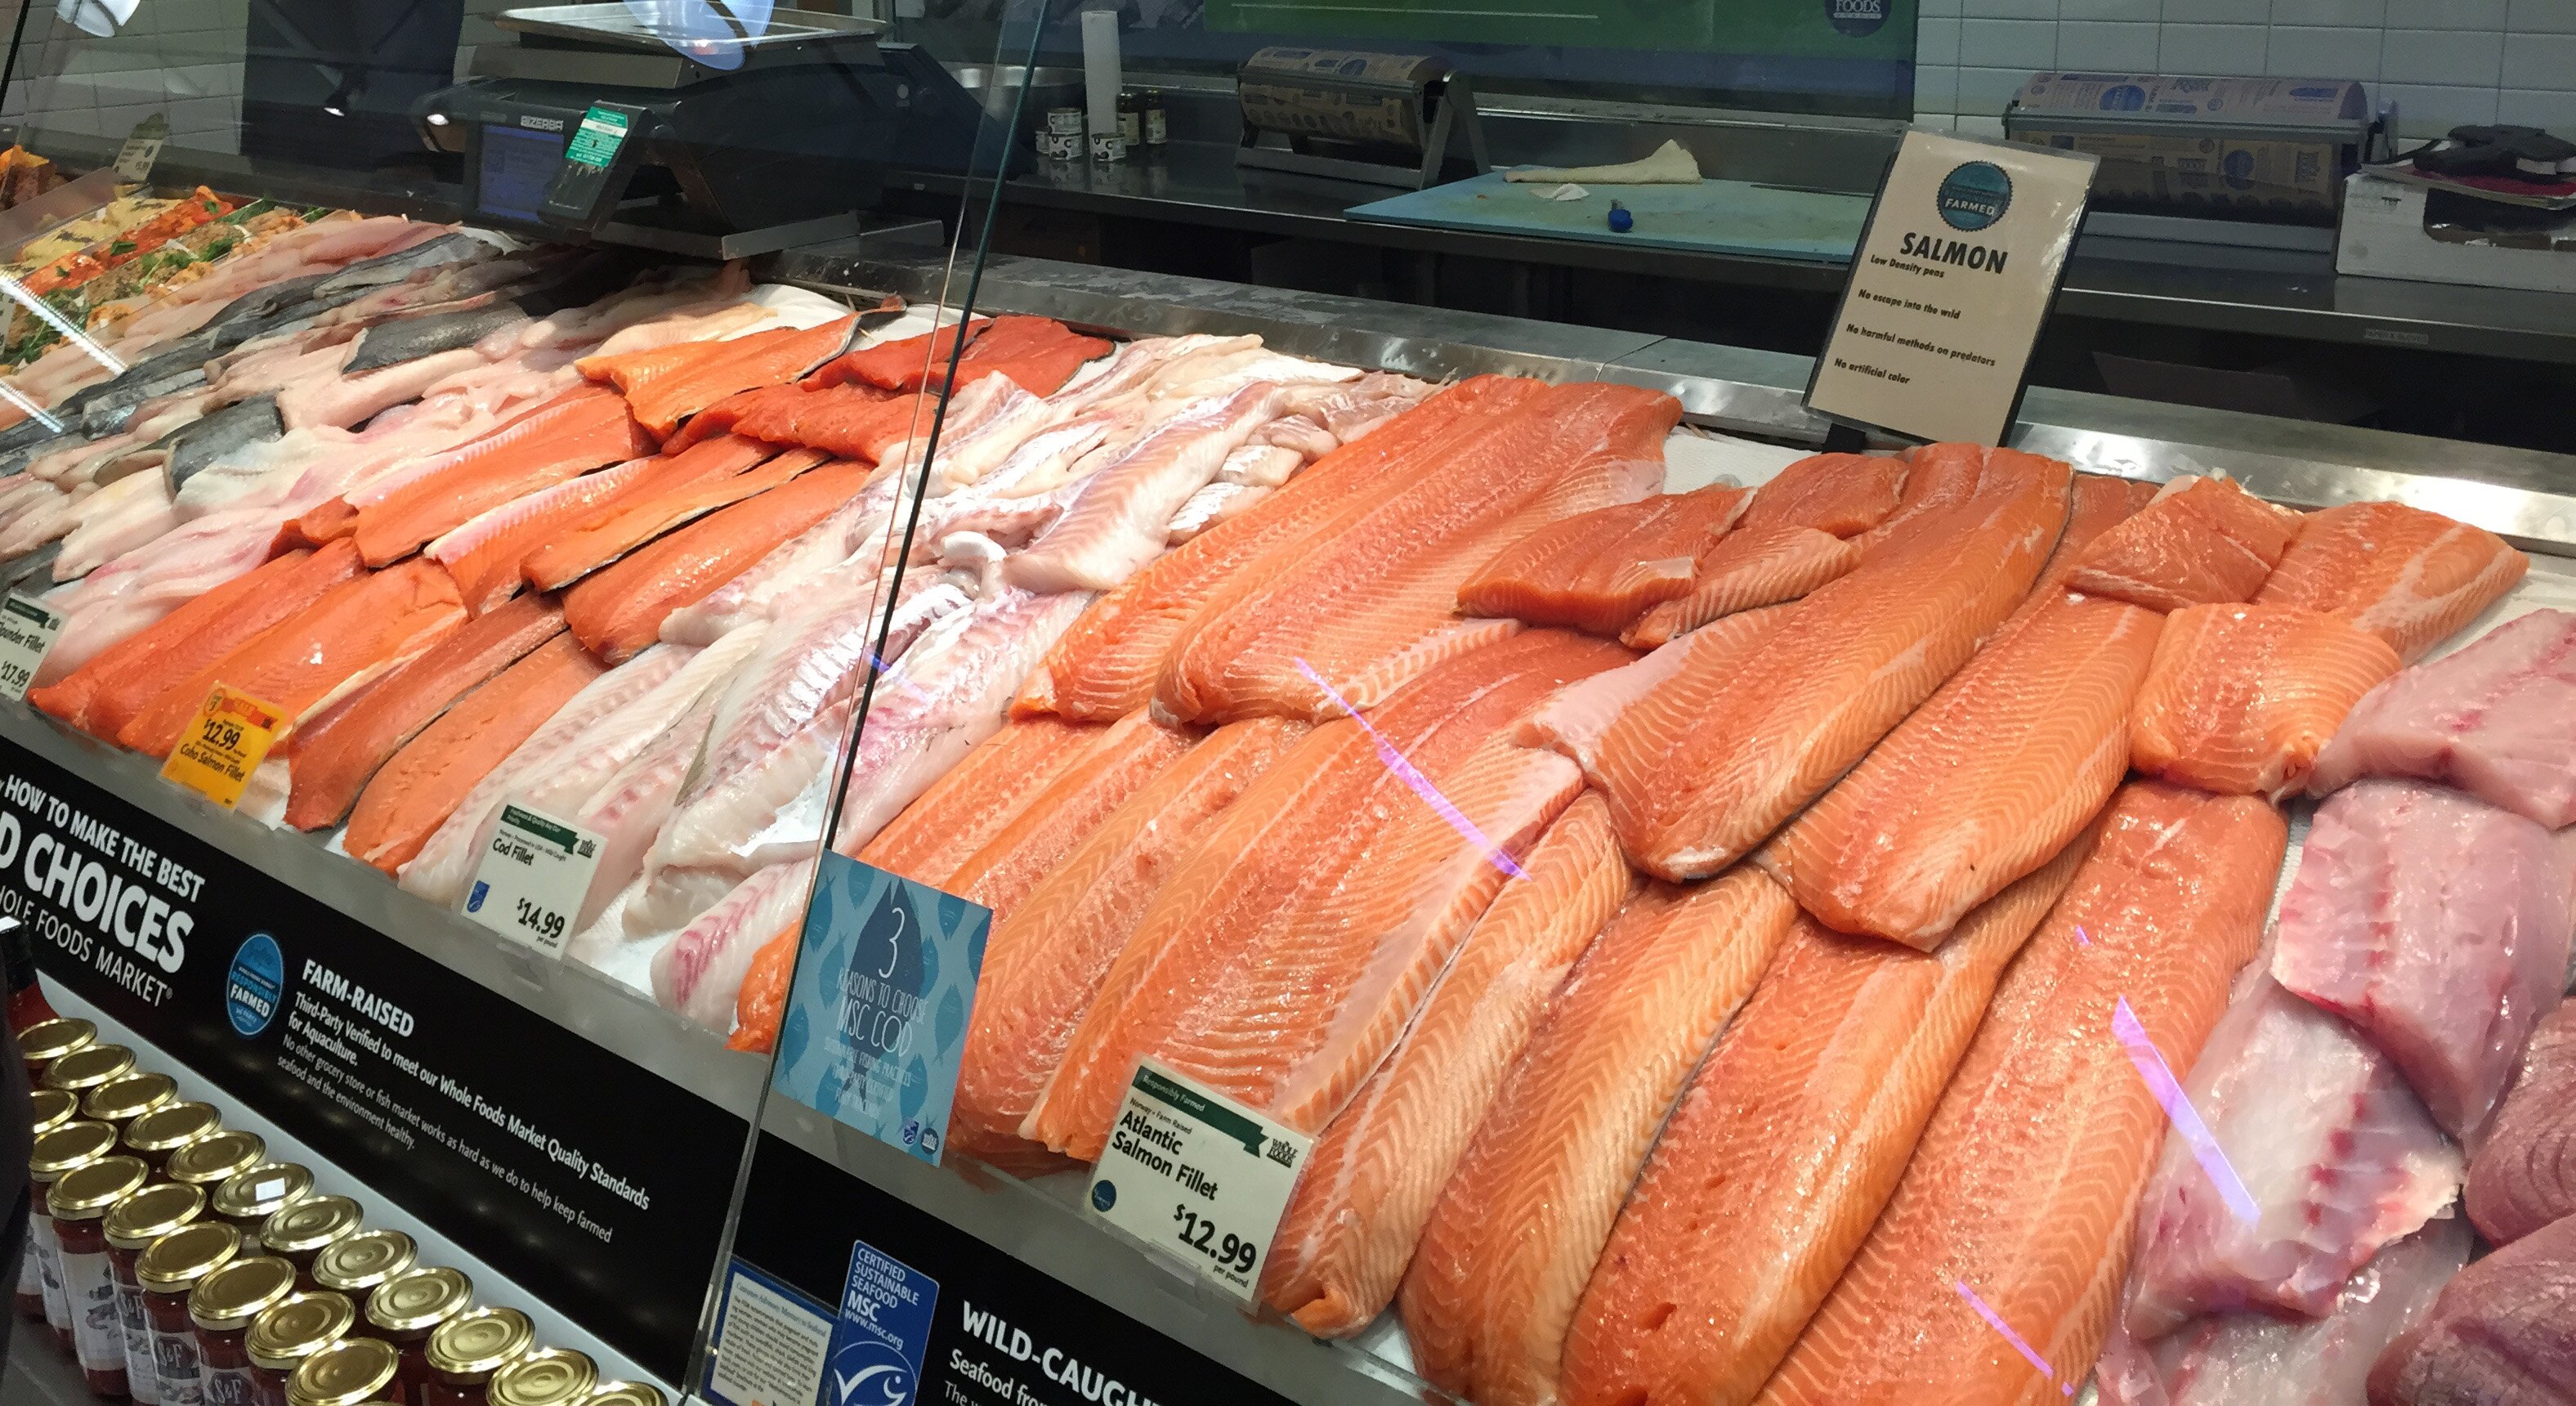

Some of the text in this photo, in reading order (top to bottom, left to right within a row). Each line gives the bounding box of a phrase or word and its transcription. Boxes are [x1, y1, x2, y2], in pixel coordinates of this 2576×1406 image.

[521, 115, 564, 132] BIZERBA
[1945, 198, 1995, 216] FARMED
[1871, 254, 1945, 279] Low Density pens
[1900, 232, 2008, 274] SALMON
[1858, 289, 1961, 320] No escape into the wild
[1846, 323, 1996, 367] No harmful methods on predators
[1834, 357, 1911, 384] No artificial color
[23, 634, 46, 653] Fillet
[1, 660, 30, 687] $17.99
[203, 719, 240, 751] $12.99
[180, 743, 199, 760] Coho
[198, 751, 225, 772] Salmon
[224, 764, 246, 782] Fillet
[4, 774, 206, 903] HOW TO MAKE THE BEST
[493, 838, 513, 856] Cod
[511, 845, 534, 866] Fillet
[24, 833, 195, 974] CHOICES
[517, 897, 565, 939] $14.99
[35, 909, 93, 962] FOODS
[878, 907, 906, 978] 3
[230, 983, 271, 1018] FARMED
[302, 958, 414, 1037] FARM-RAISED
[836, 967, 929, 1025] REASONS TO CHOOSE
[288, 1010, 358, 1067] for Aquaculture.
[837, 996, 870, 1041] MSC
[871, 1010, 913, 1057] COD
[277, 1056, 415, 1151] seafood and the environment healthy.
[295, 991, 651, 1211] Third-Party Verified to meet our Whole Foods Market Quality Standards
[1143, 1074, 1205, 1112] Responsibly Farmed
[1120, 1110, 1183, 1155] Atlantic
[1129, 1097, 1192, 1135] Norway Farm Raised
[283, 1033, 613, 1244] No other grocery store or fish market works as hard as we do to help keep farmed
[1269, 1146, 1293, 1164] FOODS
[1272, 1138, 1298, 1159] WHOLE
[1111, 1131, 1219, 1201] Salmon Fillet
[1174, 1203, 1257, 1274] $12.99
[854, 1261, 920, 1306] SUSTAINABLE
[857, 1247, 906, 1282] CERTIFIED
[1213, 1265, 1250, 1289] per pound
[847, 1290, 881, 1323] MSC
[852, 1275, 898, 1309] SEAFOOD
[845, 1309, 905, 1351] www.msc.org
[157, 1342, 183, 1369] S&F
[949, 1348, 1014, 1399] Seafood
[214, 1378, 243, 1405] S&F
[945, 1380, 968, 1406] The
